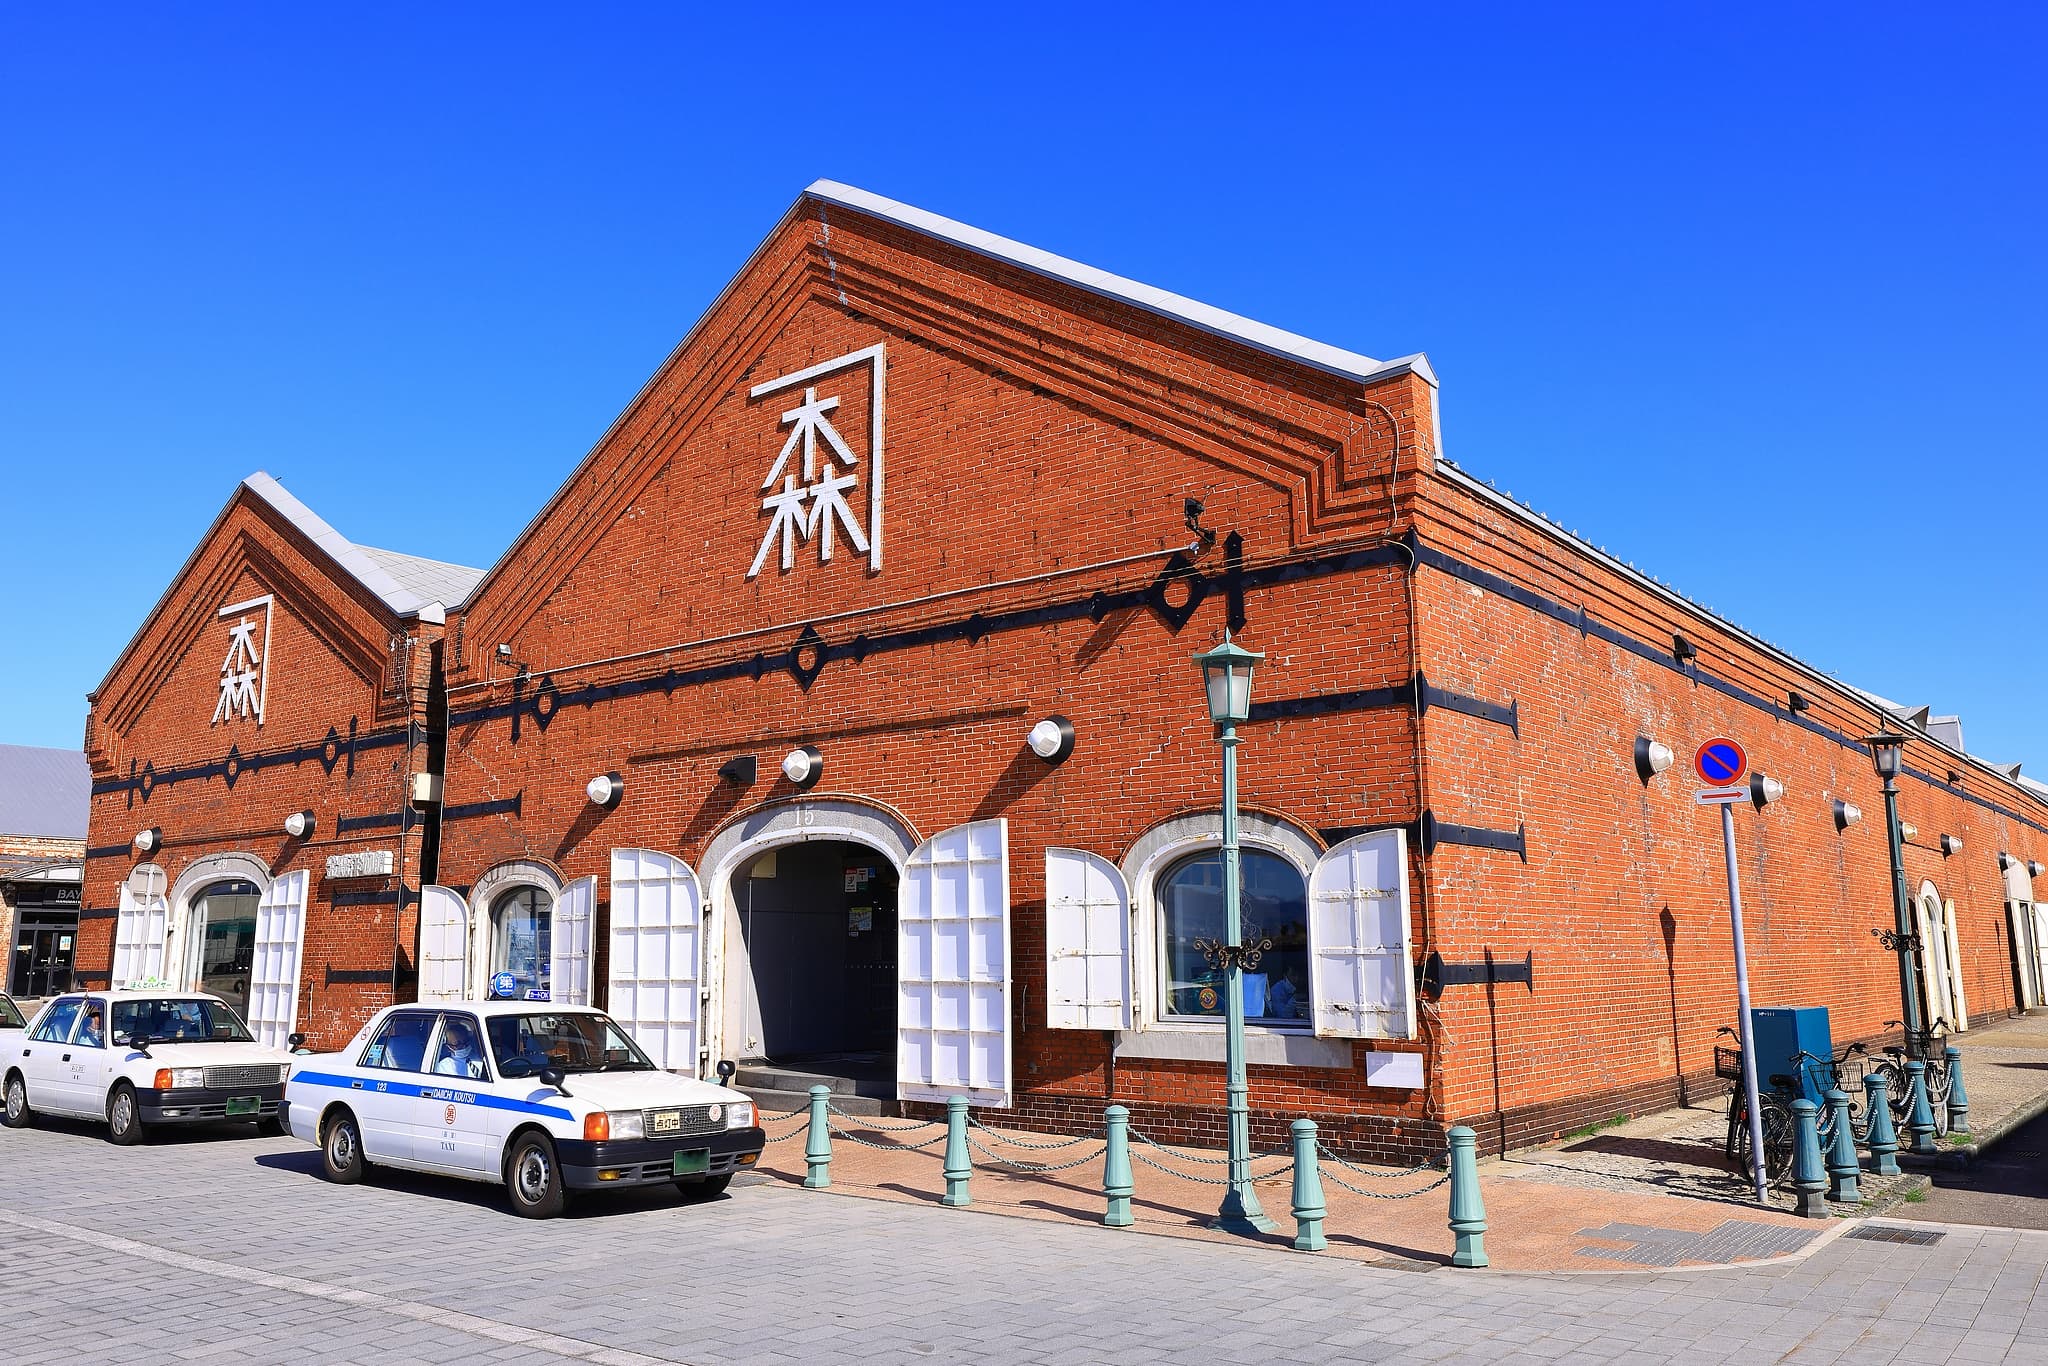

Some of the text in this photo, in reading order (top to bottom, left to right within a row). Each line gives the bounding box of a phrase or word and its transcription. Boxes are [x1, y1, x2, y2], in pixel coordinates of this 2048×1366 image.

[795, 804, 814, 825] 15
[57, 889, 81, 899] BAY
[376, 1082, 387, 1091] 123
[656, 1119, 678, 1129] 点灯中
[440, 1142, 456, 1151] TAXI
